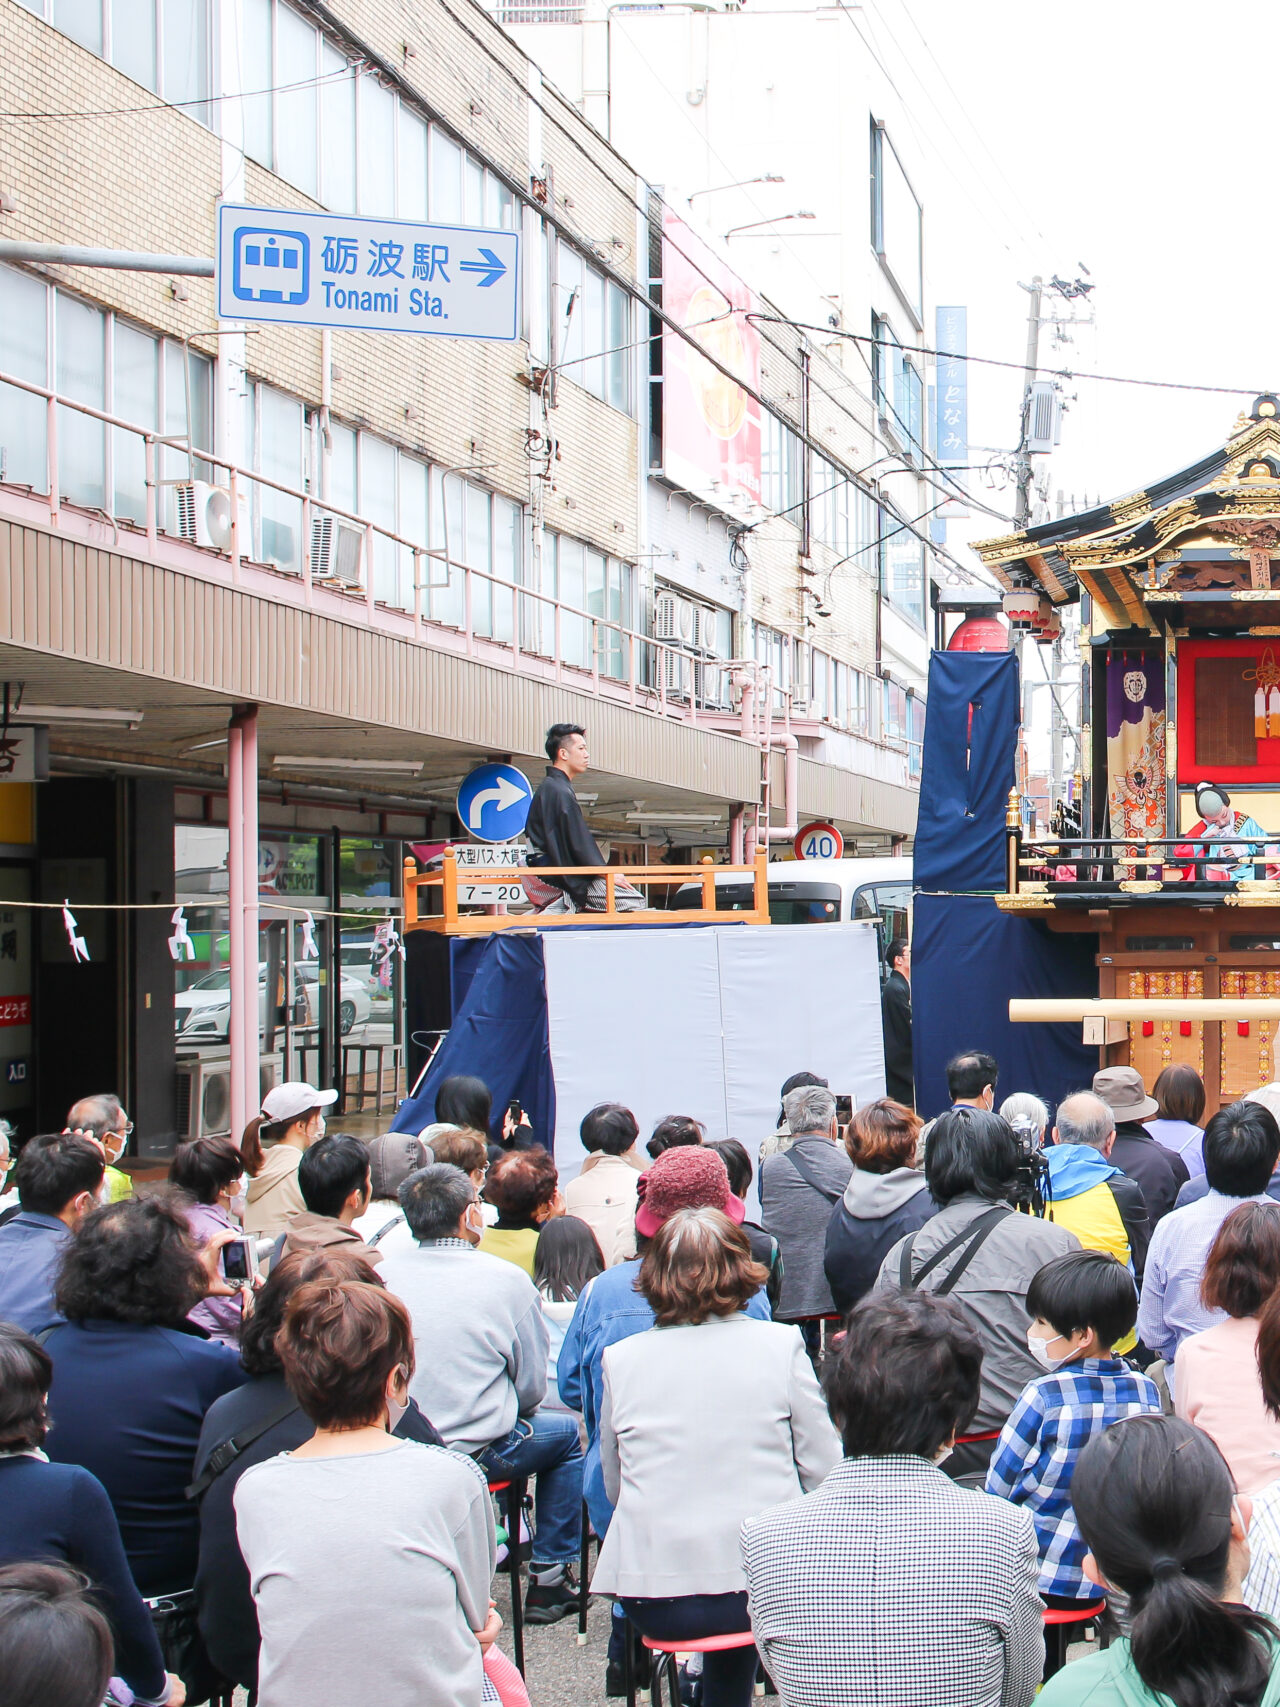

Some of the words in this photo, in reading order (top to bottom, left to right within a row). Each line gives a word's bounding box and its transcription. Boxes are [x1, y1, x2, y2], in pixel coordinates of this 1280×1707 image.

[320, 235, 451, 283] 砺波駅
[321, 281, 399, 314] Tonami
[409, 288, 448, 319] Sta.
[945, 316, 959, 378] ビジネステル
[805, 836, 833, 859] 40
[8, 1063, 26, 1081] 入口
